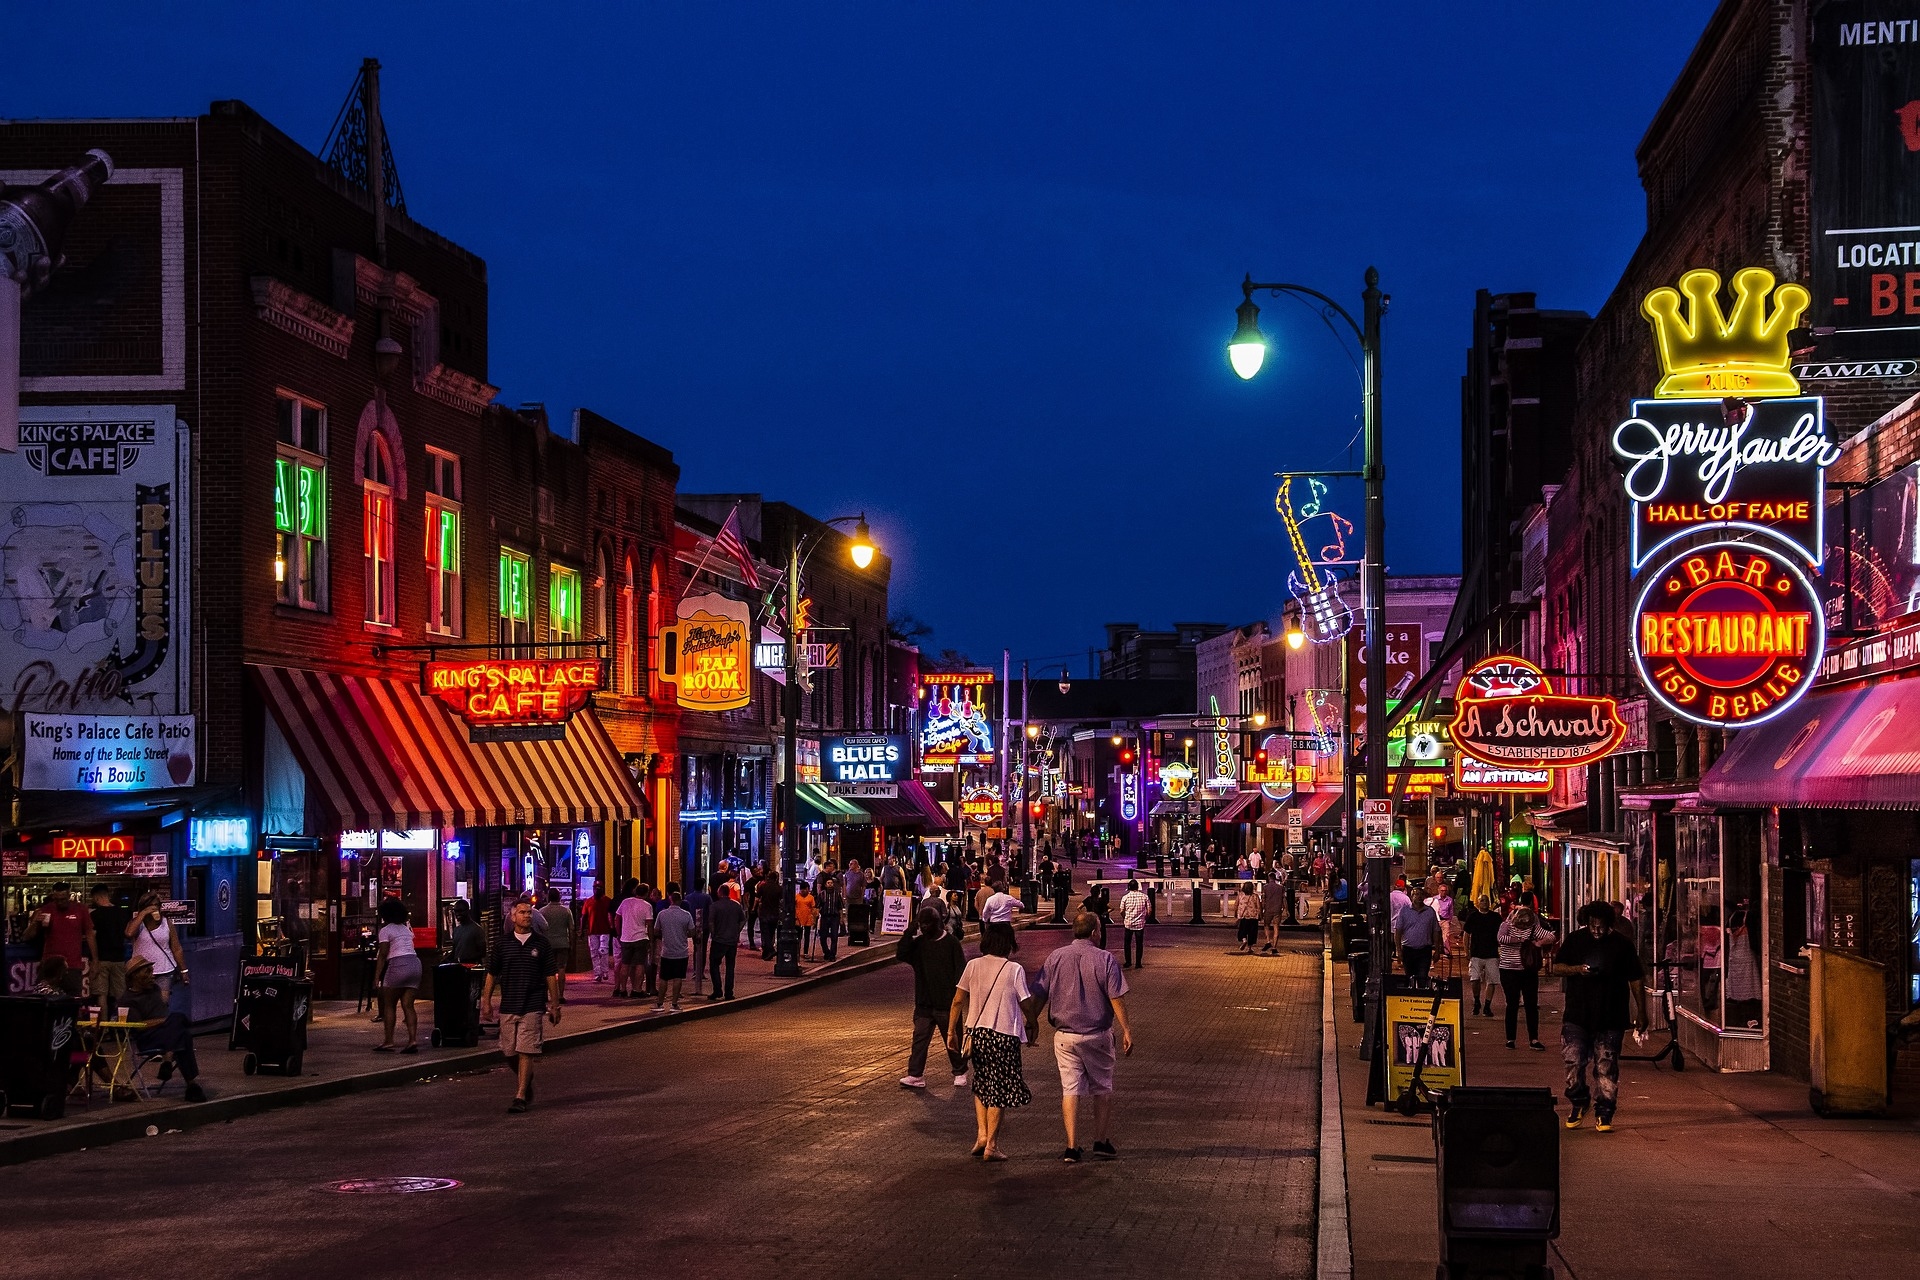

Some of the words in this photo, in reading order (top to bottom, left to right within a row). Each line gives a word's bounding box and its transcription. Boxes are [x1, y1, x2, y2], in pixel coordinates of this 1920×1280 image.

[1799, 363, 1904, 378] LAMAR
[20, 425, 79, 442] KING'S
[82, 424, 145, 441] PALACE
[51, 447, 116, 471] CAFE
[1612, 418, 1731, 501] Jerry
[1704, 402, 1842, 504] Lawler
[1650, 504, 1704, 521] HALL
[1709, 503, 1740, 520] OF
[1749, 502, 1809, 520] FAME
[140, 503, 166, 641] BLUES
[1685, 551, 1768, 587] BAR
[1399, 632, 1409, 641] a
[1643, 614, 1810, 655] RESTAURANT
[698, 656, 738, 673] TAP
[1357, 644, 1410, 665] Cke
[433, 664, 499, 688] KING'S
[508, 666, 595, 685] PALACE
[682, 670, 741, 690] ROOM
[1468, 663, 1541, 690] PIG
[11, 660, 123, 714] Patio
[1655, 664, 1698, 703] 159
[1710, 663, 1801, 718] BEALE
[469, 691, 560, 715] CAFE
[30, 720, 73, 742] King's
[78, 722, 120, 740] Palace
[125, 722, 154, 740] Cafe
[158, 722, 191, 740] Patio
[1495, 704, 1617, 738] Schwab
[52, 747, 81, 760] Home
[84, 747, 96, 763] of
[97, 747, 112, 760] the
[115, 747, 141, 760] Beale
[143, 747, 169, 760] Street
[832, 745, 899, 762] BLUES
[1488, 745, 1566, 758] ESTABLISHED
[1570, 745, 1591, 758] 1876
[77, 766, 103, 783] Fish
[107, 765, 146, 783] Bowls
[839, 764, 892, 780] HALL
[1461, 771, 1481, 784] AN
[832, 786, 858, 795] JUKE
[862, 786, 892, 795] JOINT
[963, 802, 991, 813] BEALE
[1370, 802, 1386, 812] NO
[61, 837, 125, 858] PATIO
